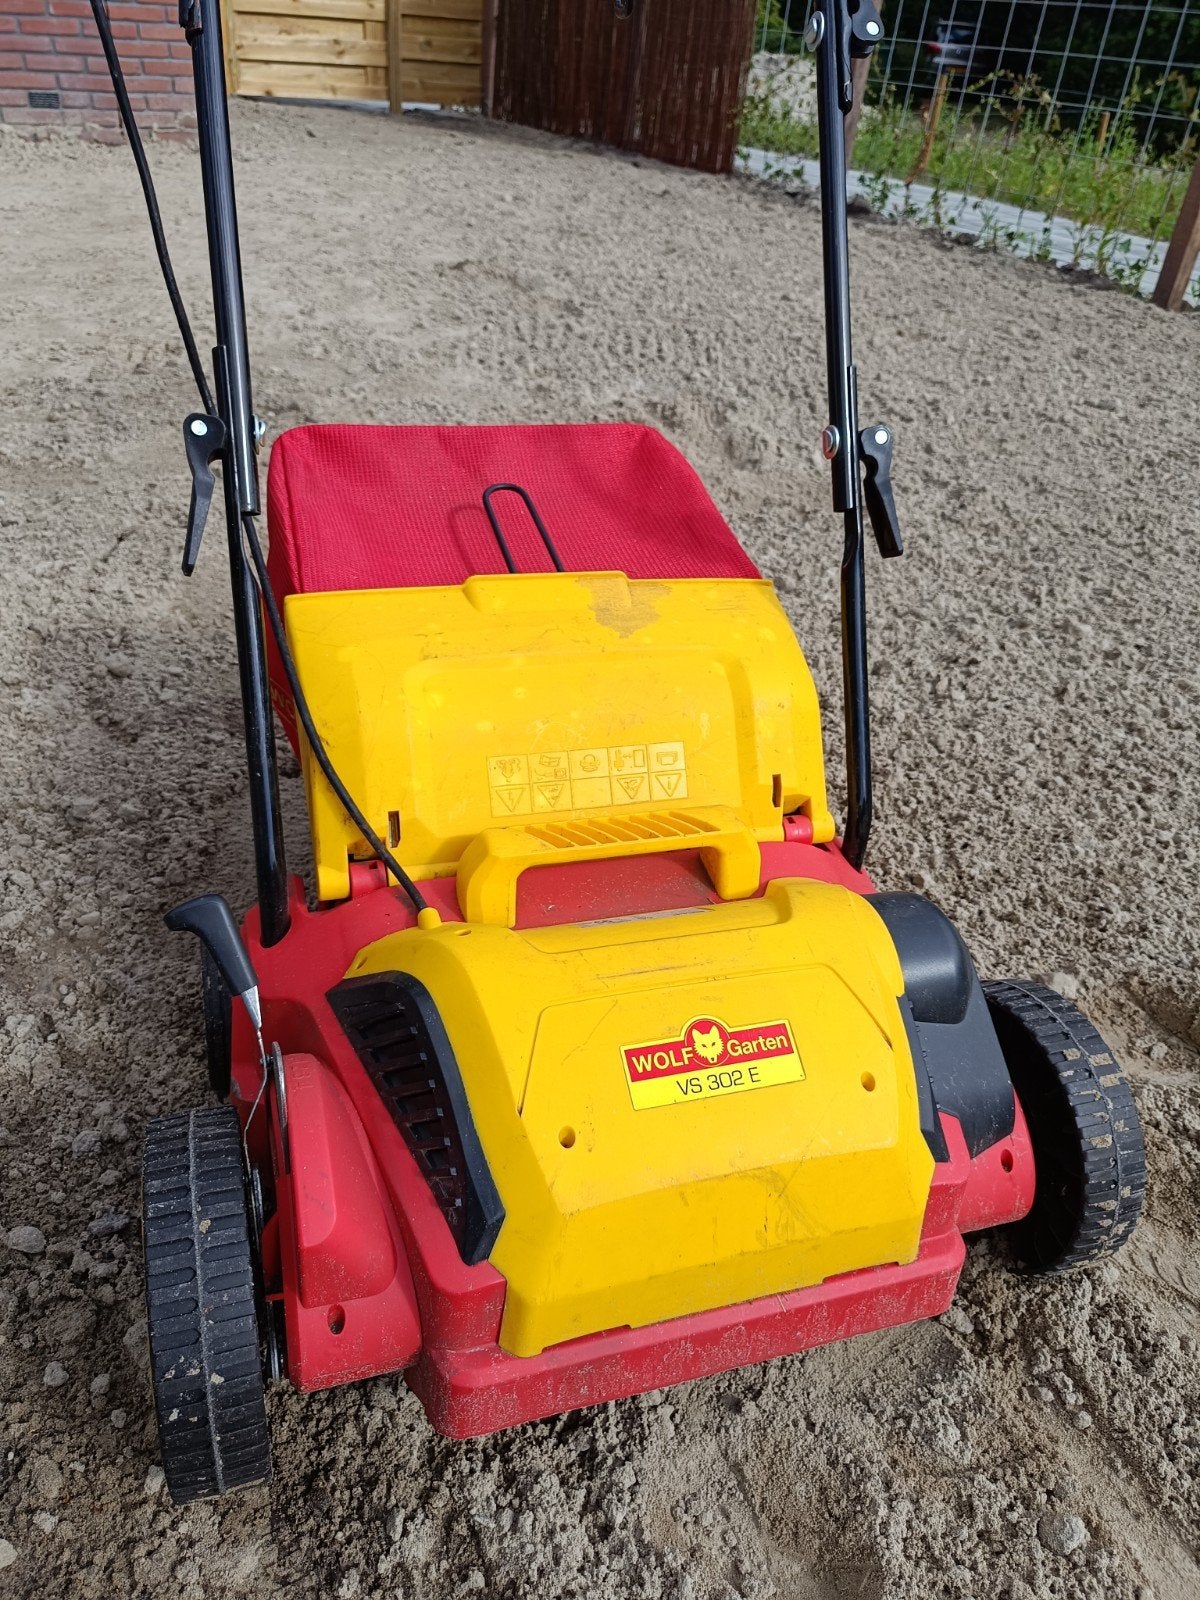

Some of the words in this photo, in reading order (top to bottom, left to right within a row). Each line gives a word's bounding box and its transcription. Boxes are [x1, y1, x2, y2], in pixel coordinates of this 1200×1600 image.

[631, 1048, 694, 1073] WOLF
[727, 1034, 788, 1057] Garten
[676, 1078, 703, 1095] VS
[706, 1070, 744, 1091] 302
[749, 1067, 761, 1083] E
